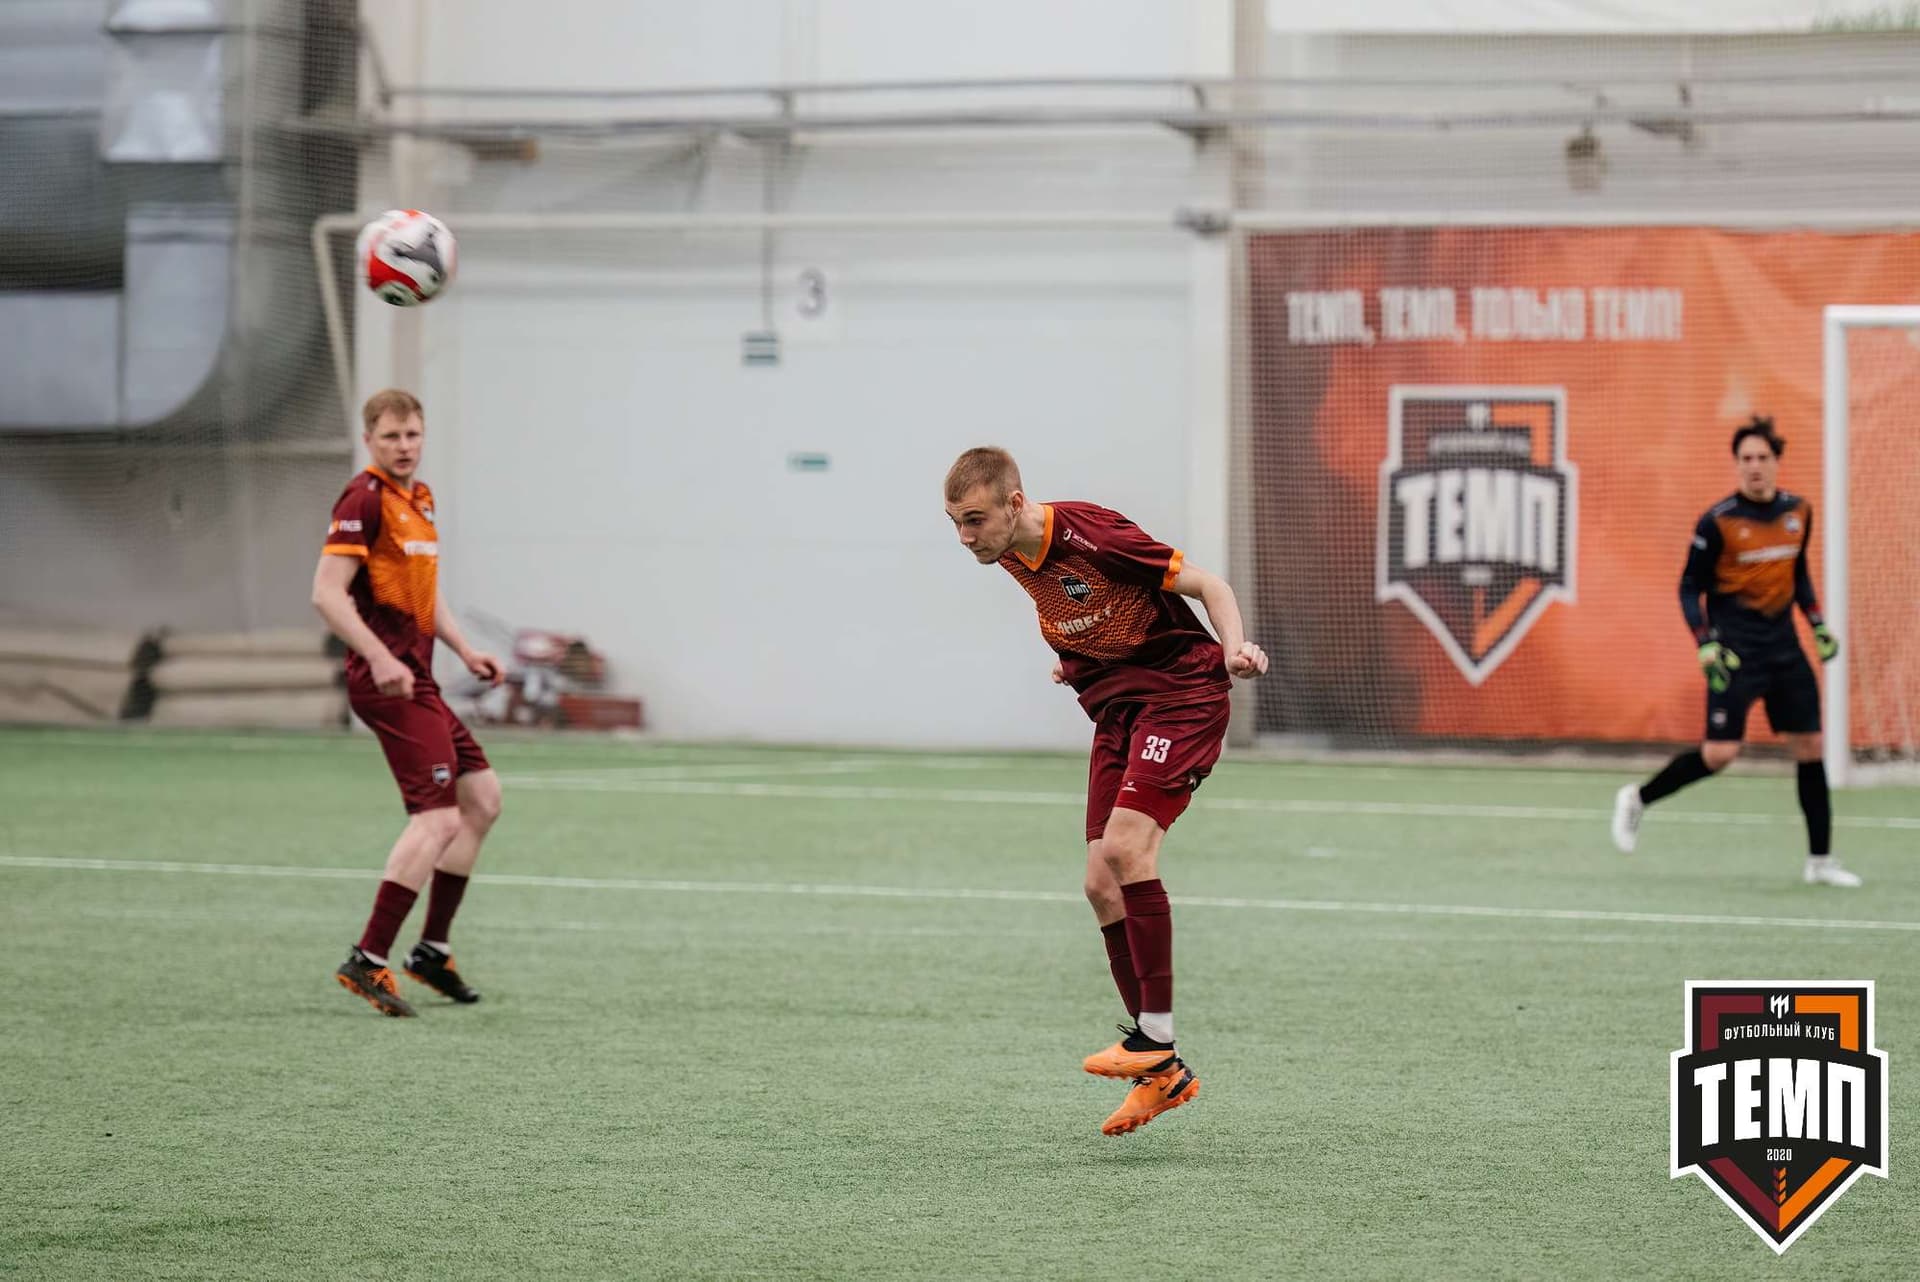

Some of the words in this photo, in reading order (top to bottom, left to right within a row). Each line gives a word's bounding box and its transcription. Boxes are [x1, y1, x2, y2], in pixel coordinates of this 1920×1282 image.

[797, 268, 827, 321] 3
[1396, 467, 1559, 573] ТЕМП
[1141, 735, 1172, 764] 33
